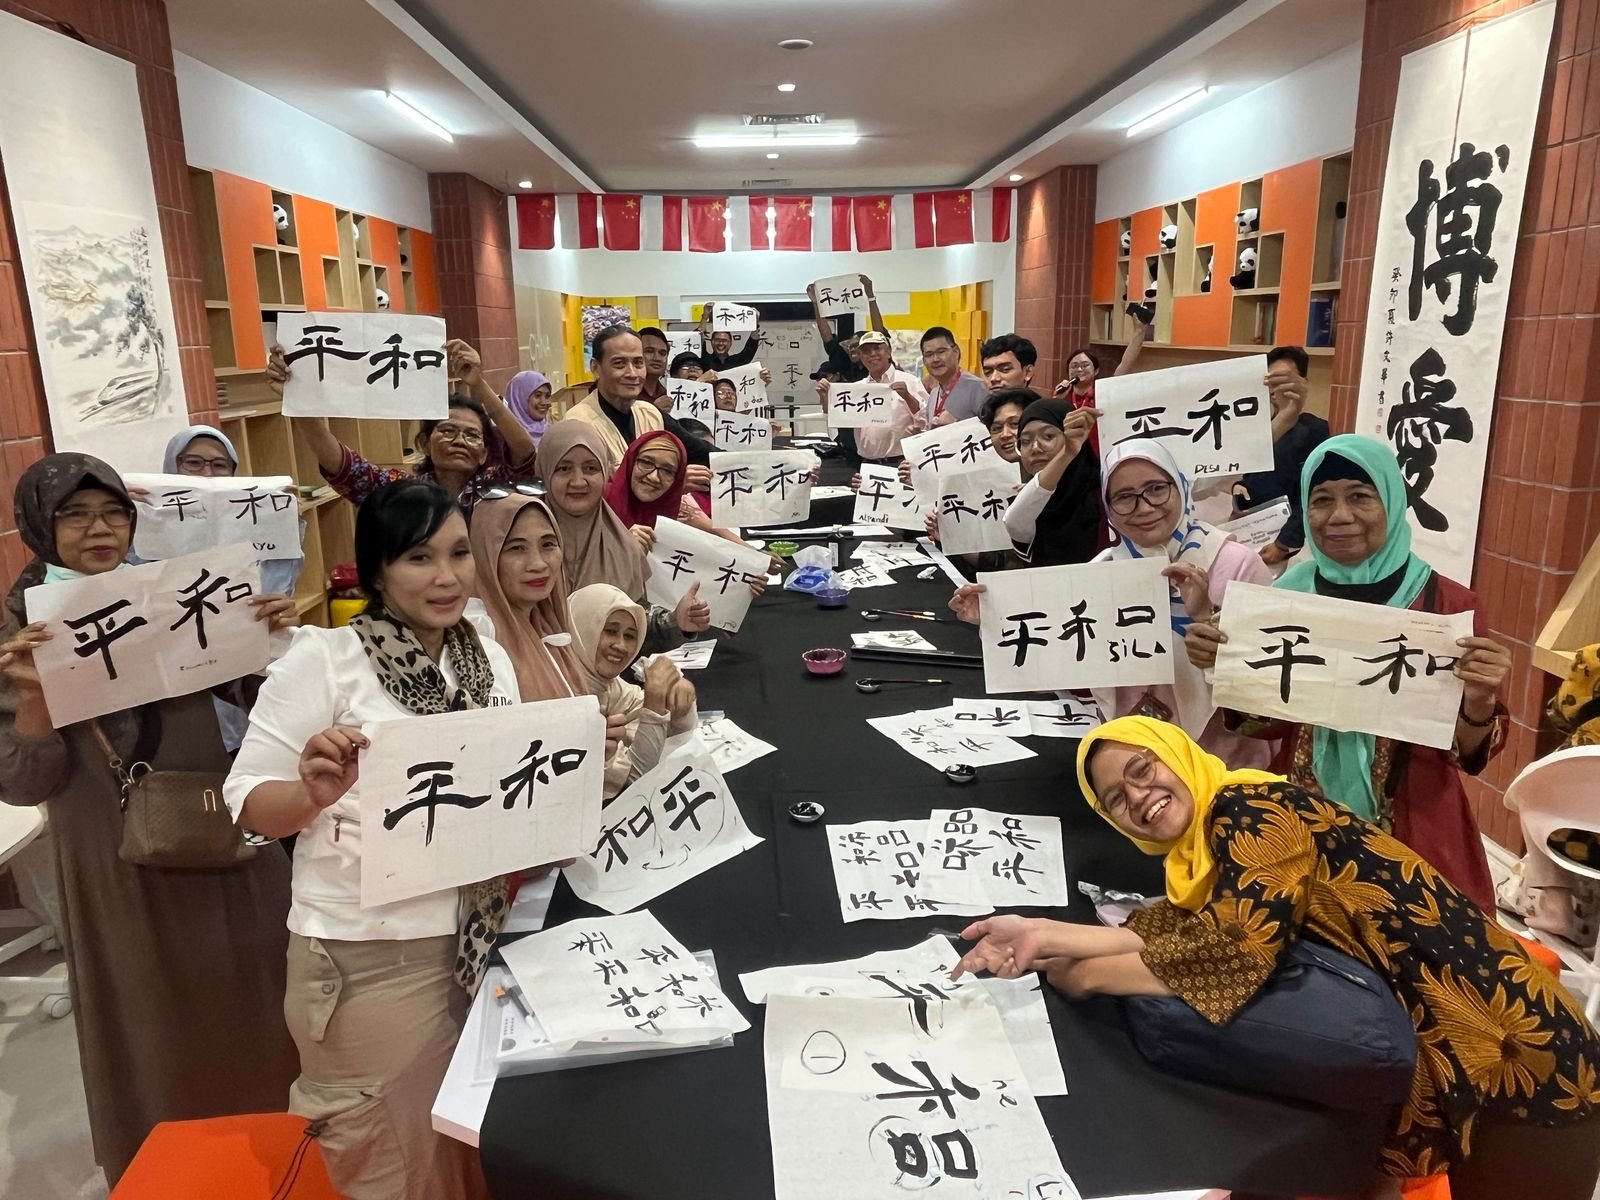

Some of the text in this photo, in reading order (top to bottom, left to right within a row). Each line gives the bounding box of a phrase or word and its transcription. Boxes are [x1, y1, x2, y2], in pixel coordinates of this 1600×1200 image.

[820, 287, 863, 306] 平和
[284, 325, 445, 389] 平和
[1387, 142, 1510, 532] 博愛
[834, 391, 884, 412] 平和
[716, 420, 767, 445] 平和
[161, 486, 292, 524] 平和
[716, 463, 810, 507] 平和
[661, 549, 758, 595] 平和
[63, 568, 253, 680] 平和
[1244, 625, 1460, 704] 平和
[383, 739, 588, 847] 平和
